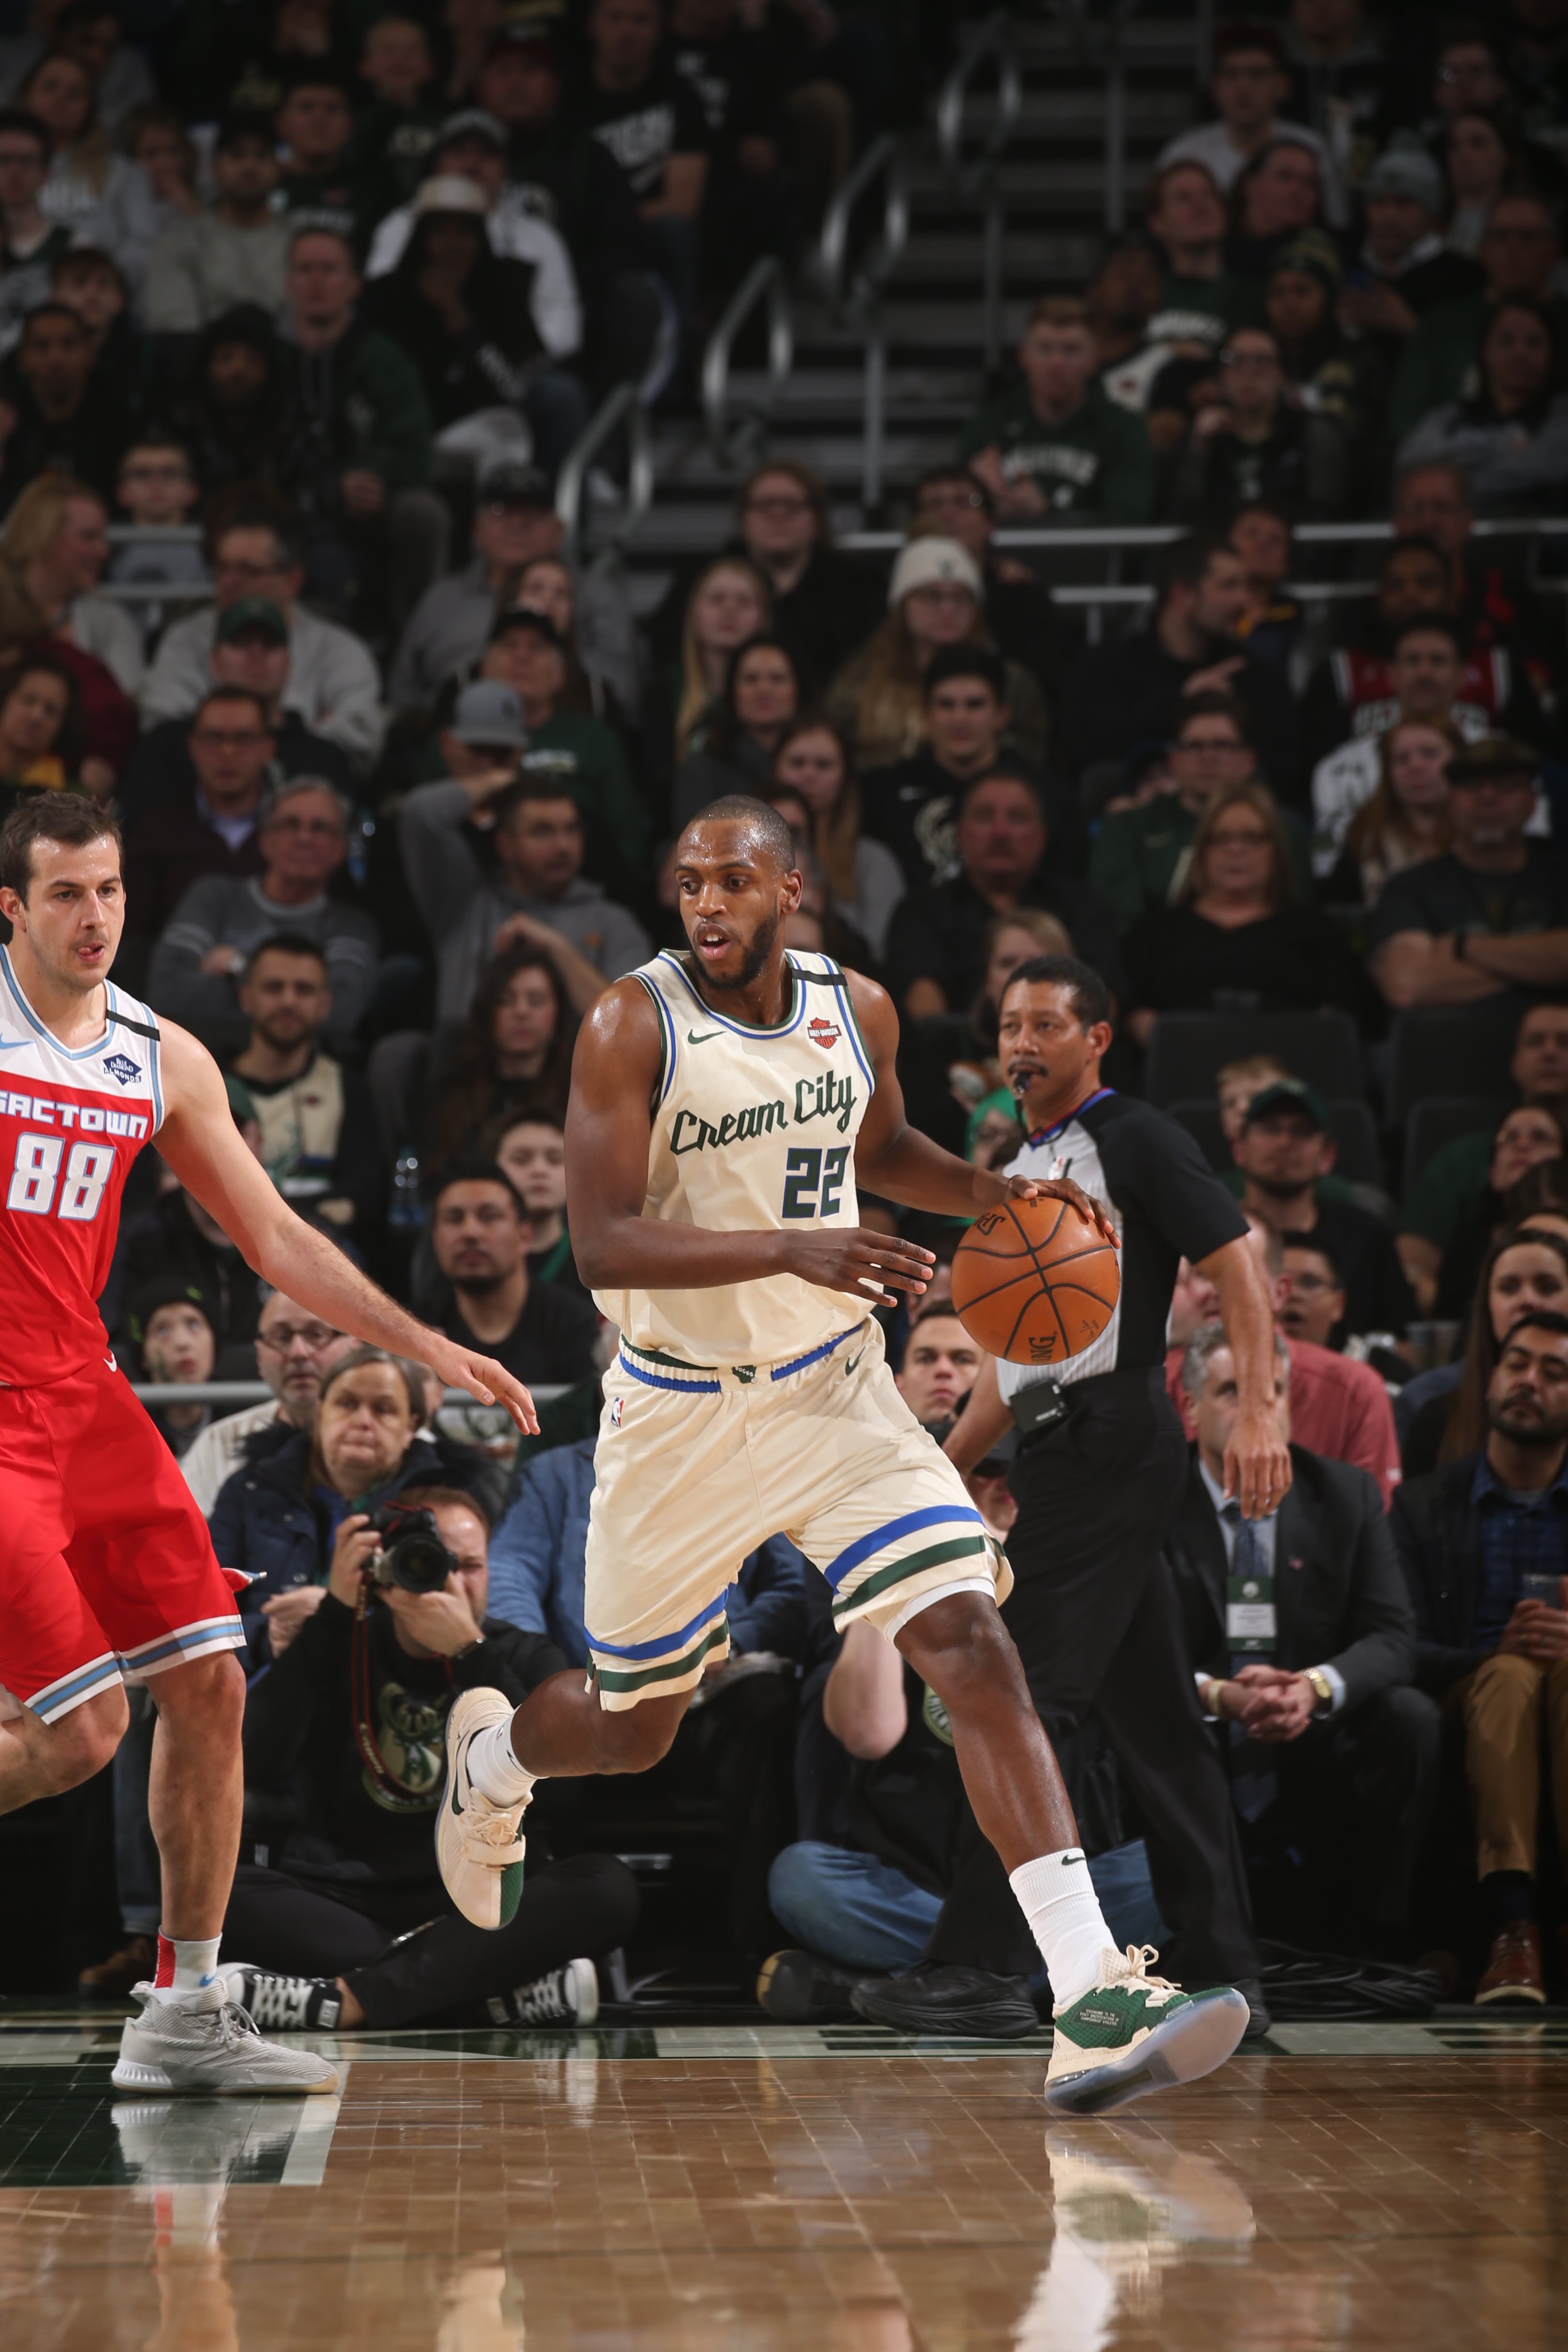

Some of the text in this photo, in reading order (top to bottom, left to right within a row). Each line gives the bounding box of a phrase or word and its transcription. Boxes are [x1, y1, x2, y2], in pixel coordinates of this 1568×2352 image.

[104, 1067, 140, 1082] ALMONDS
[110, 1061, 134, 1073] DIAMOND
[669, 1070, 857, 1155] Cream City
[6, 1131, 116, 1222] 88
[781, 1146, 851, 1218] 22
[735, 1365, 754, 1377] BUCKS
